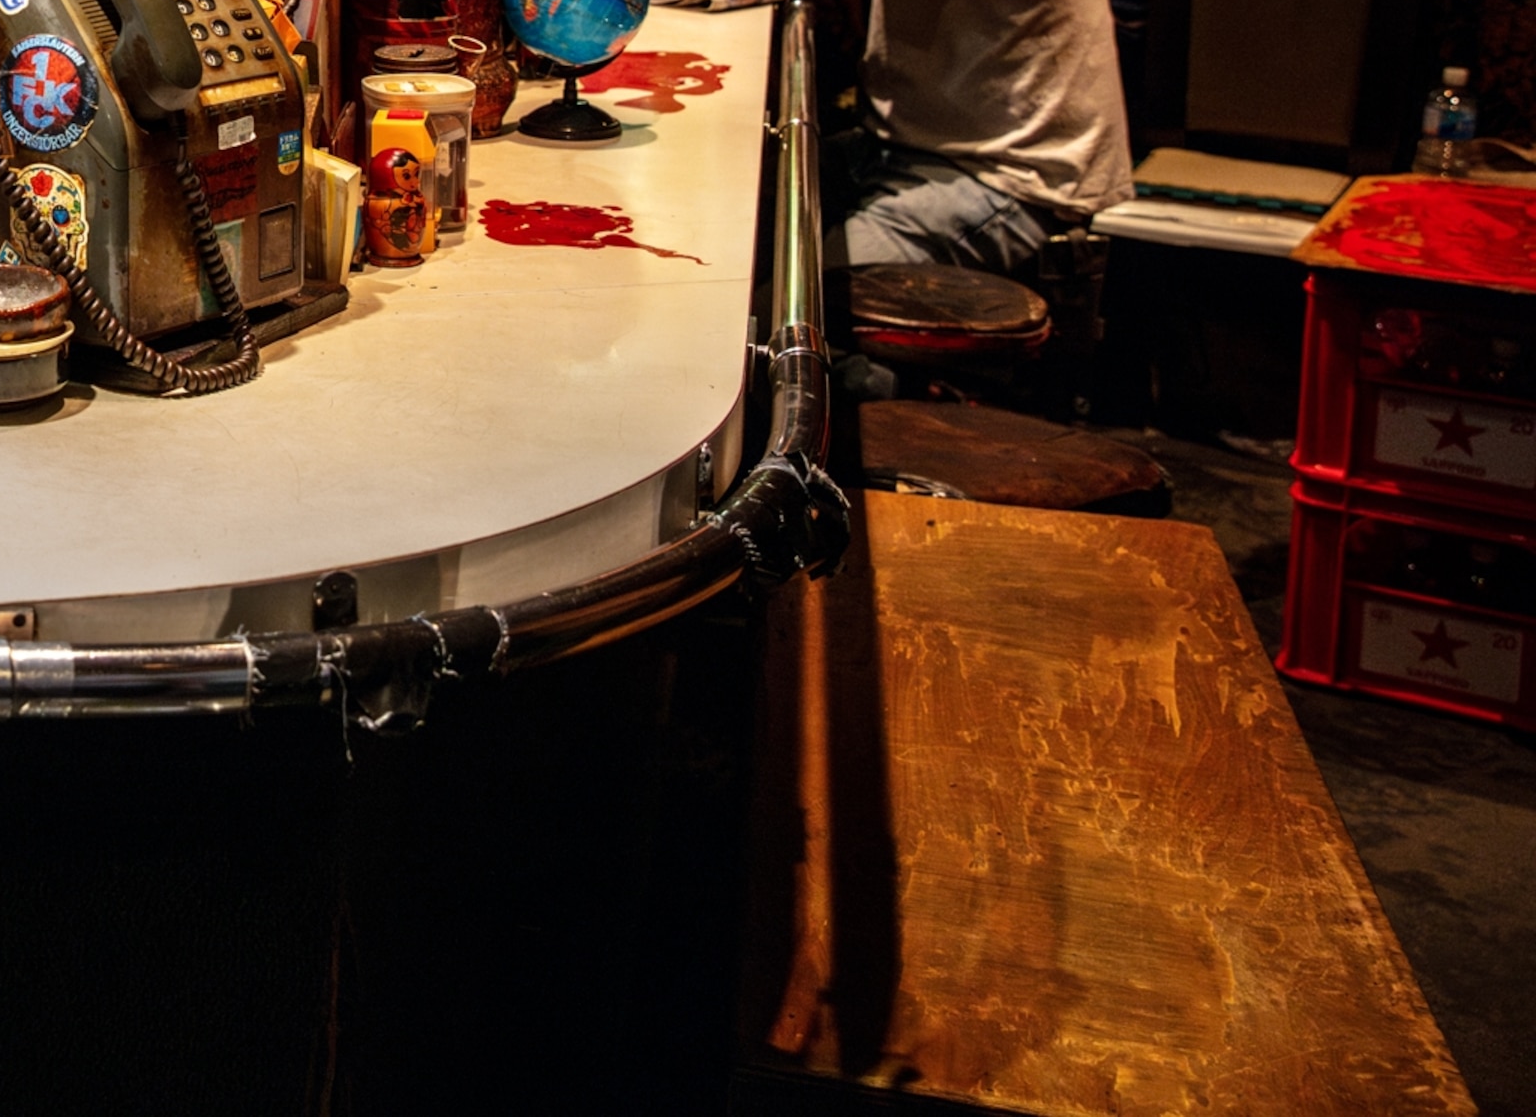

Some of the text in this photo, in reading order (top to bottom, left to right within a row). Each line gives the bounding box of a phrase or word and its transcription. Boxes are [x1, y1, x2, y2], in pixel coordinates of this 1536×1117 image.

[31, 50, 51, 81] 1
[2, 110, 83, 152] UNZERSTÖRBAR
[1509, 415, 1535, 436] 20
[1420, 455, 1487, 478] SAPPORO
[1492, 631, 1517, 651] 20
